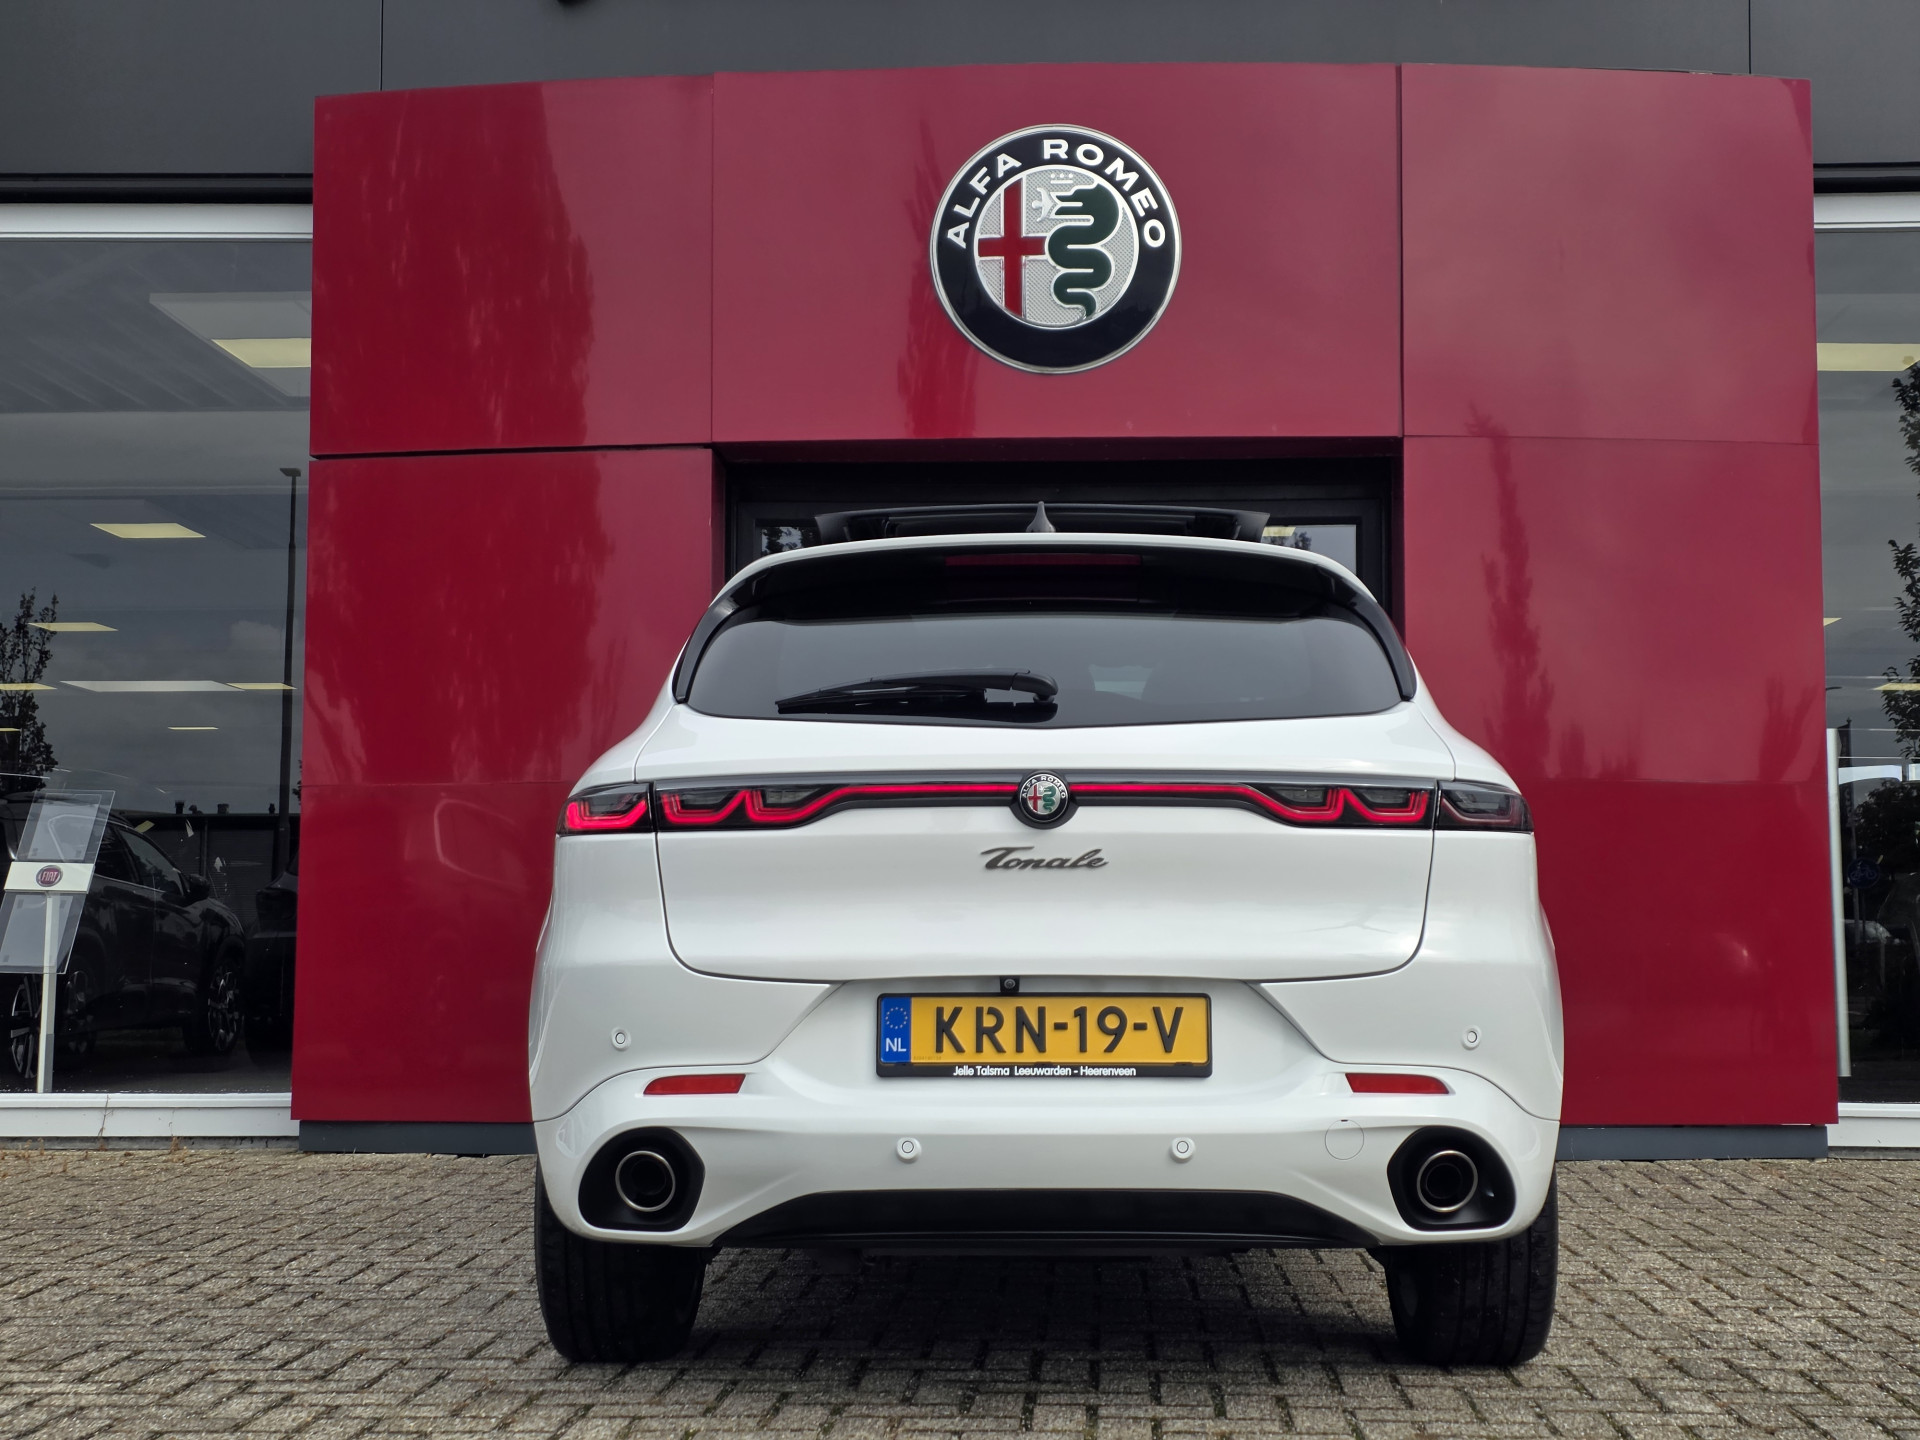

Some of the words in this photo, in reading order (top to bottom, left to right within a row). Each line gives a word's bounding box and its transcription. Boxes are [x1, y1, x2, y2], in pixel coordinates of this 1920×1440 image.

[947, 153, 1022, 249] ALFA
[1043, 139, 1166, 248] ROMEO
[1021, 779, 1038, 799] ALFA
[1041, 775, 1066, 799] ROMEO
[980, 846, 1109, 870] Tonale
[42, 871, 59, 882] FIAT
[935, 1006, 1184, 1054] KRN-19-V
[885, 1037, 907, 1052] NL
[953, 1065, 974, 1076] Jelle
[976, 1065, 1010, 1076] Talsma
[1014, 1065, 1072, 1076] Leeuwarden
[1080, 1065, 1137, 1076] Heerenveen
